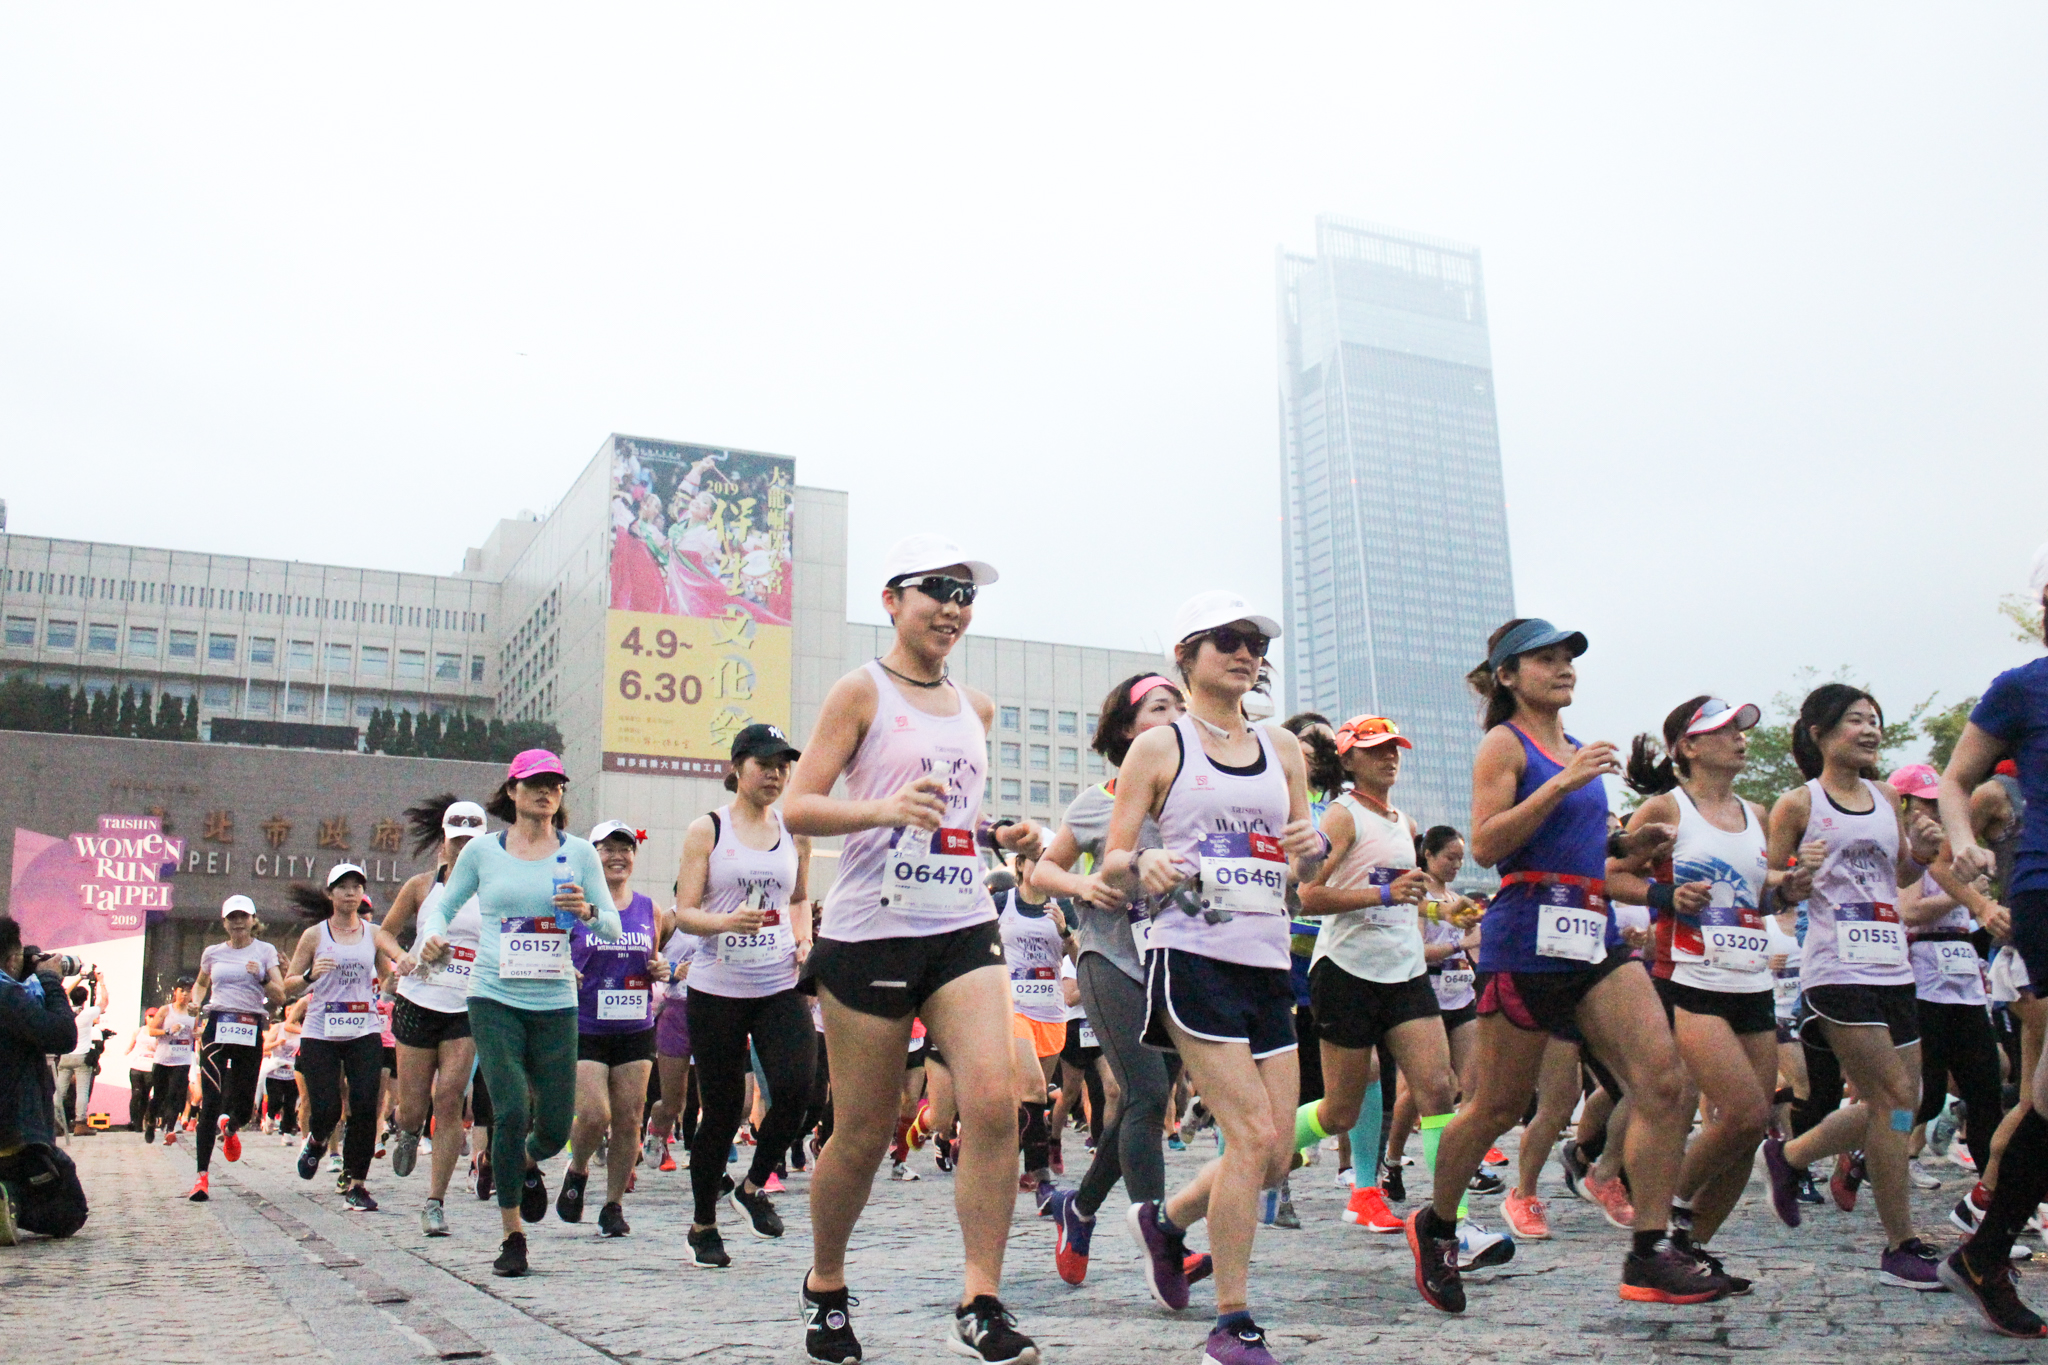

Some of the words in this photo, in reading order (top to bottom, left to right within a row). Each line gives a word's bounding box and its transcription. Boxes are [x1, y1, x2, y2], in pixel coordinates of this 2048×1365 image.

[707, 480, 739, 496] 2019
[620, 626, 693, 659] 4.9~
[619, 669, 702, 705] 6.30
[149, 806, 403, 853] 北市政府
[255, 854, 315, 878] CITY
[894, 862, 973, 885] 06470
[1216, 867, 1281, 889] 06461
[111, 915, 138, 925] 2019
[1556, 916, 1600, 939] 0119
[725, 933, 775, 947] 03323
[1713, 933, 1769, 952] 03207
[1849, 929, 1898, 944] 01553
[510, 939, 560, 952] 06157
[447, 964, 471, 977] 852
[1016, 984, 1054, 993] 02296
[605, 995, 642, 1005] 01255
[329, 1017, 365, 1026] 06407
[220, 1026, 253, 1036] 04294
